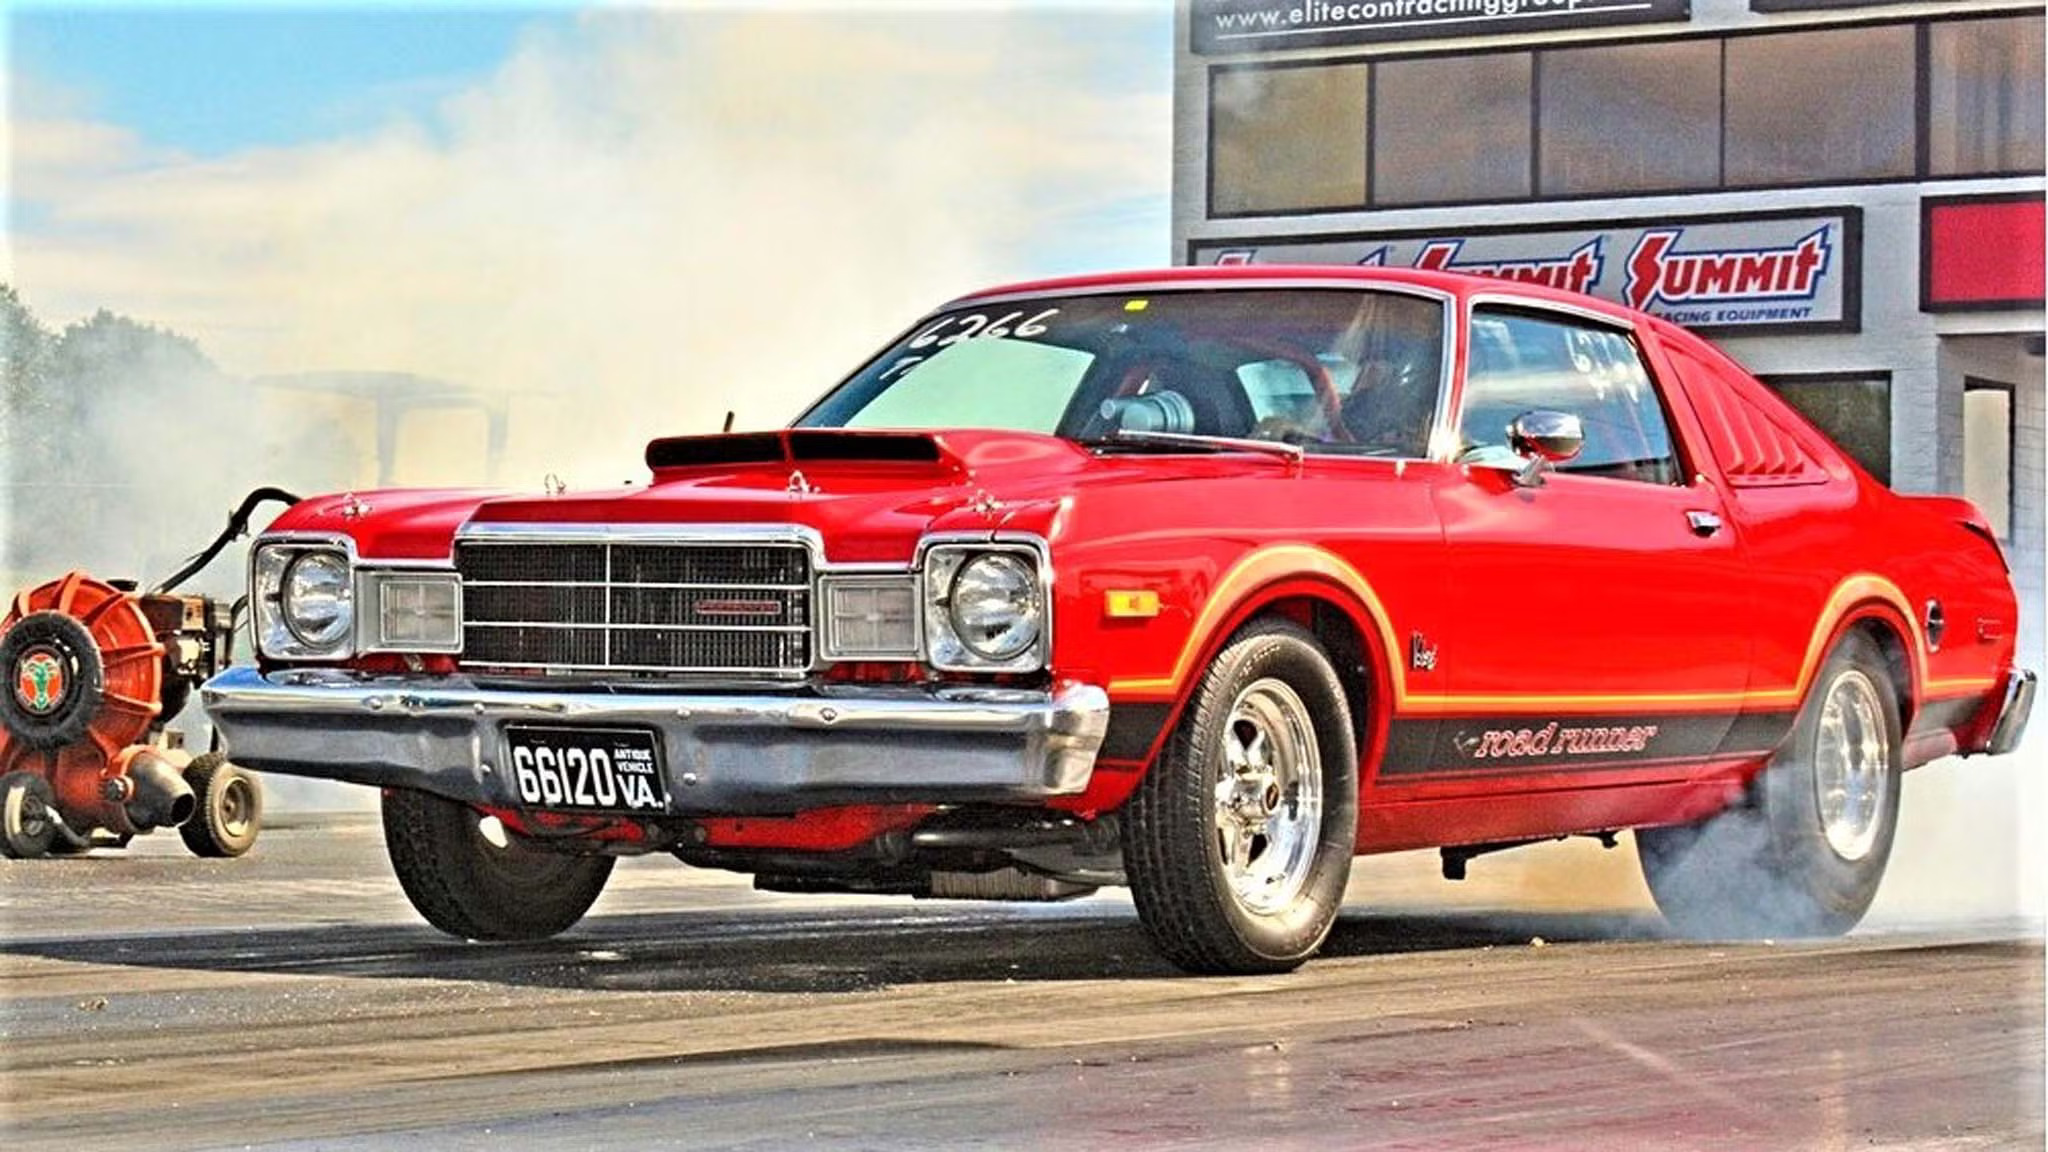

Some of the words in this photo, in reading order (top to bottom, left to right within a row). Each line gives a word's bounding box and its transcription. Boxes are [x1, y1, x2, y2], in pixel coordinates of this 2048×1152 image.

[1717, 307, 1812, 321] EQUIPMENT
[1474, 722, 1558, 758] road
[1550, 725, 1658, 754] runner
[613, 748, 652, 760] ANTIQUE
[616, 761, 654, 774] VEHICLE
[513, 746, 617, 806] 66120
